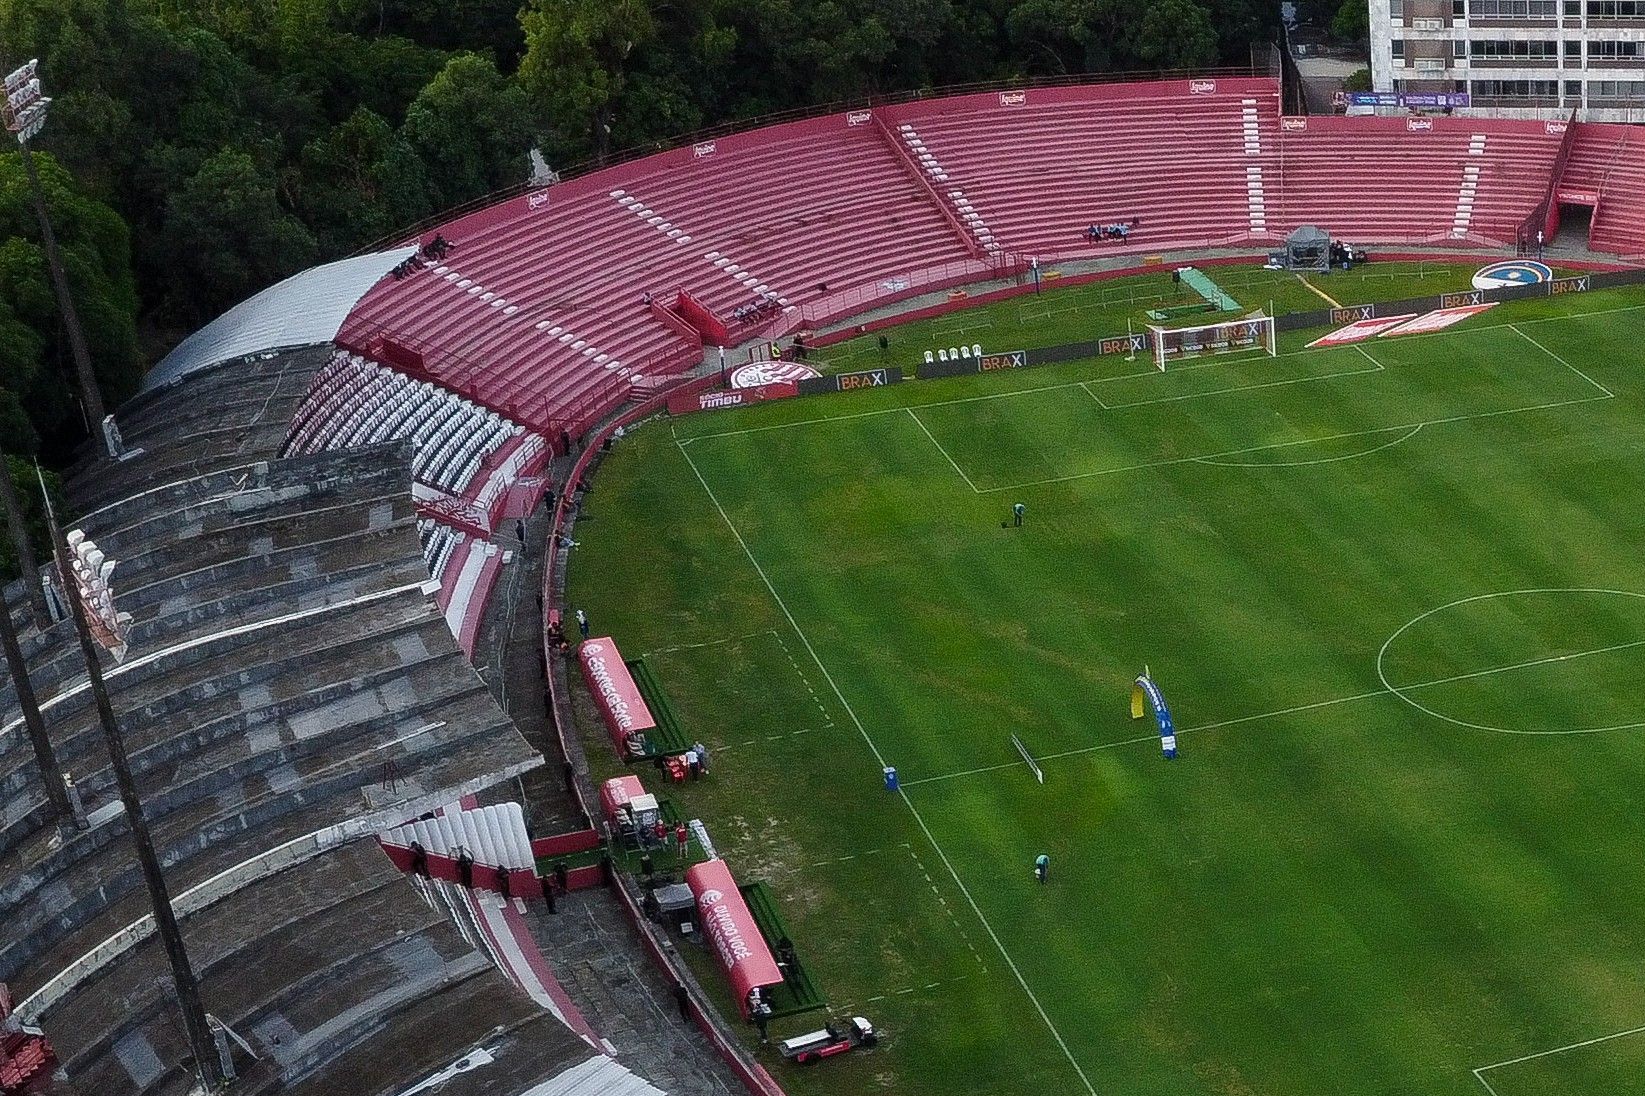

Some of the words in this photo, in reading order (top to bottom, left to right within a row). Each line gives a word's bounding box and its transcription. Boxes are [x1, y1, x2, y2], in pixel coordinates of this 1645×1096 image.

[1552, 277, 1586, 293] BRAX
[1444, 293, 1480, 307] BRAX
[1334, 308, 1370, 323] BRAX
[1103, 337, 1141, 352] BRAX
[983, 356, 1021, 370] BRAX
[842, 373, 883, 390] BRAX
[700, 394, 741, 408] TIMBU
[714, 905, 738, 937] OUVIDO
